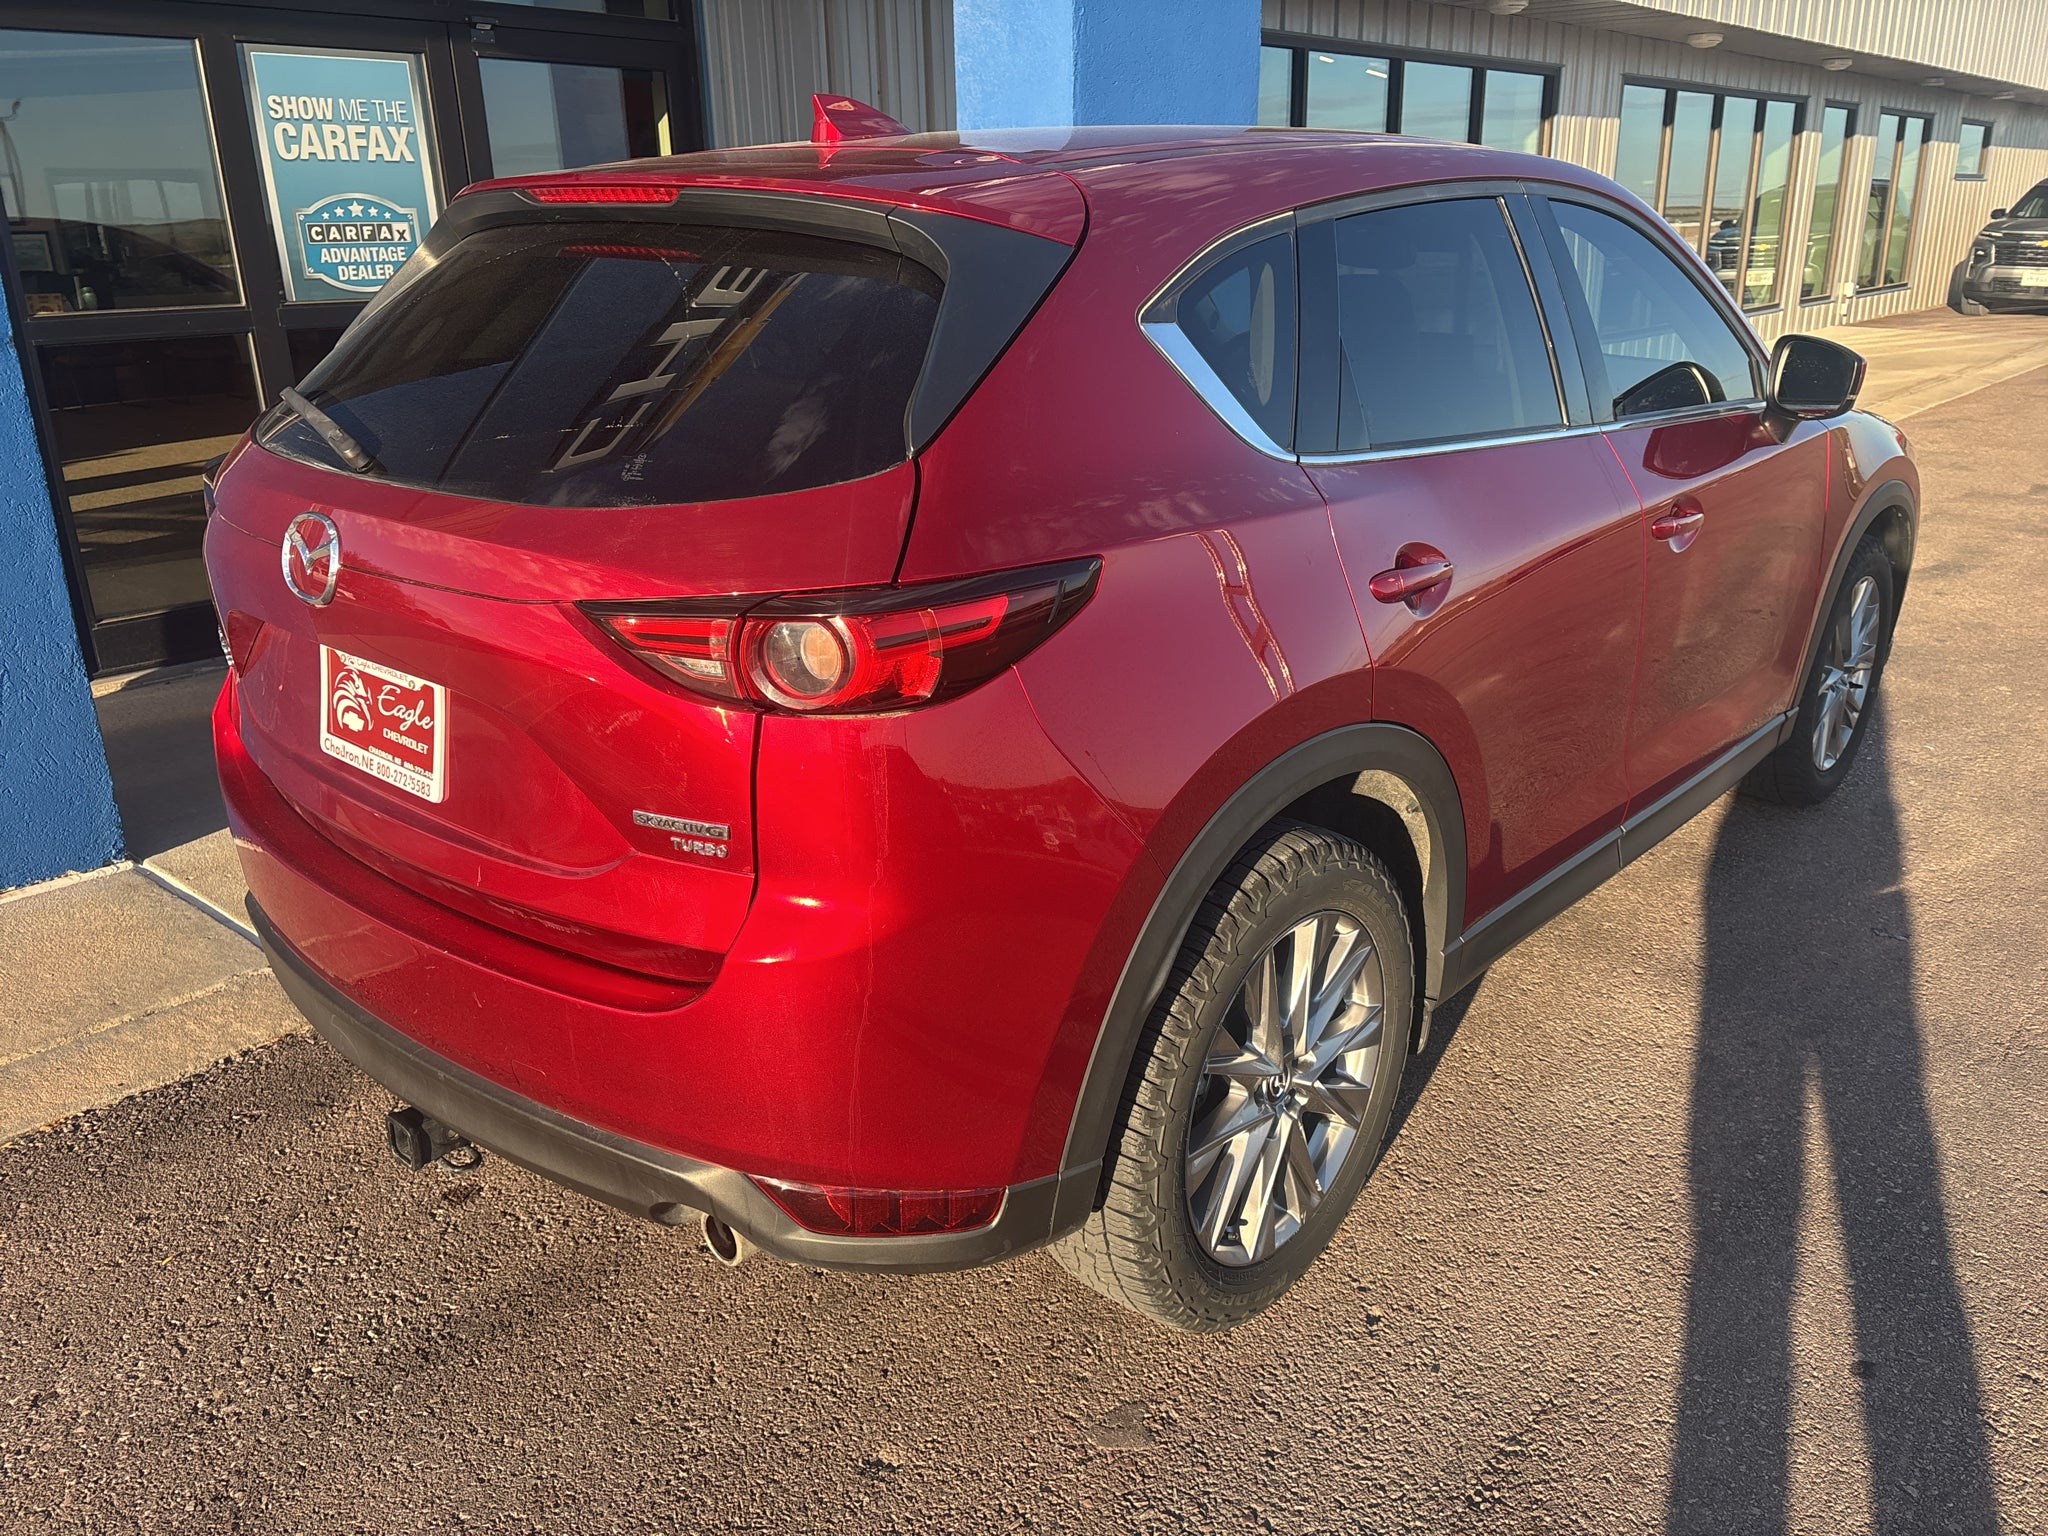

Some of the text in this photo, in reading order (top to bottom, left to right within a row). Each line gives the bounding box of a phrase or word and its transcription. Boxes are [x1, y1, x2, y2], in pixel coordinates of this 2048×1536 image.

[267, 95, 409, 124] SHOW ME THE
[273, 122, 415, 163] CARFAX
[309, 225, 408, 242] CARFAX
[320, 247, 407, 264] ADVANTAGE
[338, 264, 394, 281] DEALER
[377, 684, 434, 731] Eagle
[383, 728, 429, 755] CHEVROLET
[376, 762, 431, 798] 800-272-5583
[670, 836, 728, 858] TURBO
